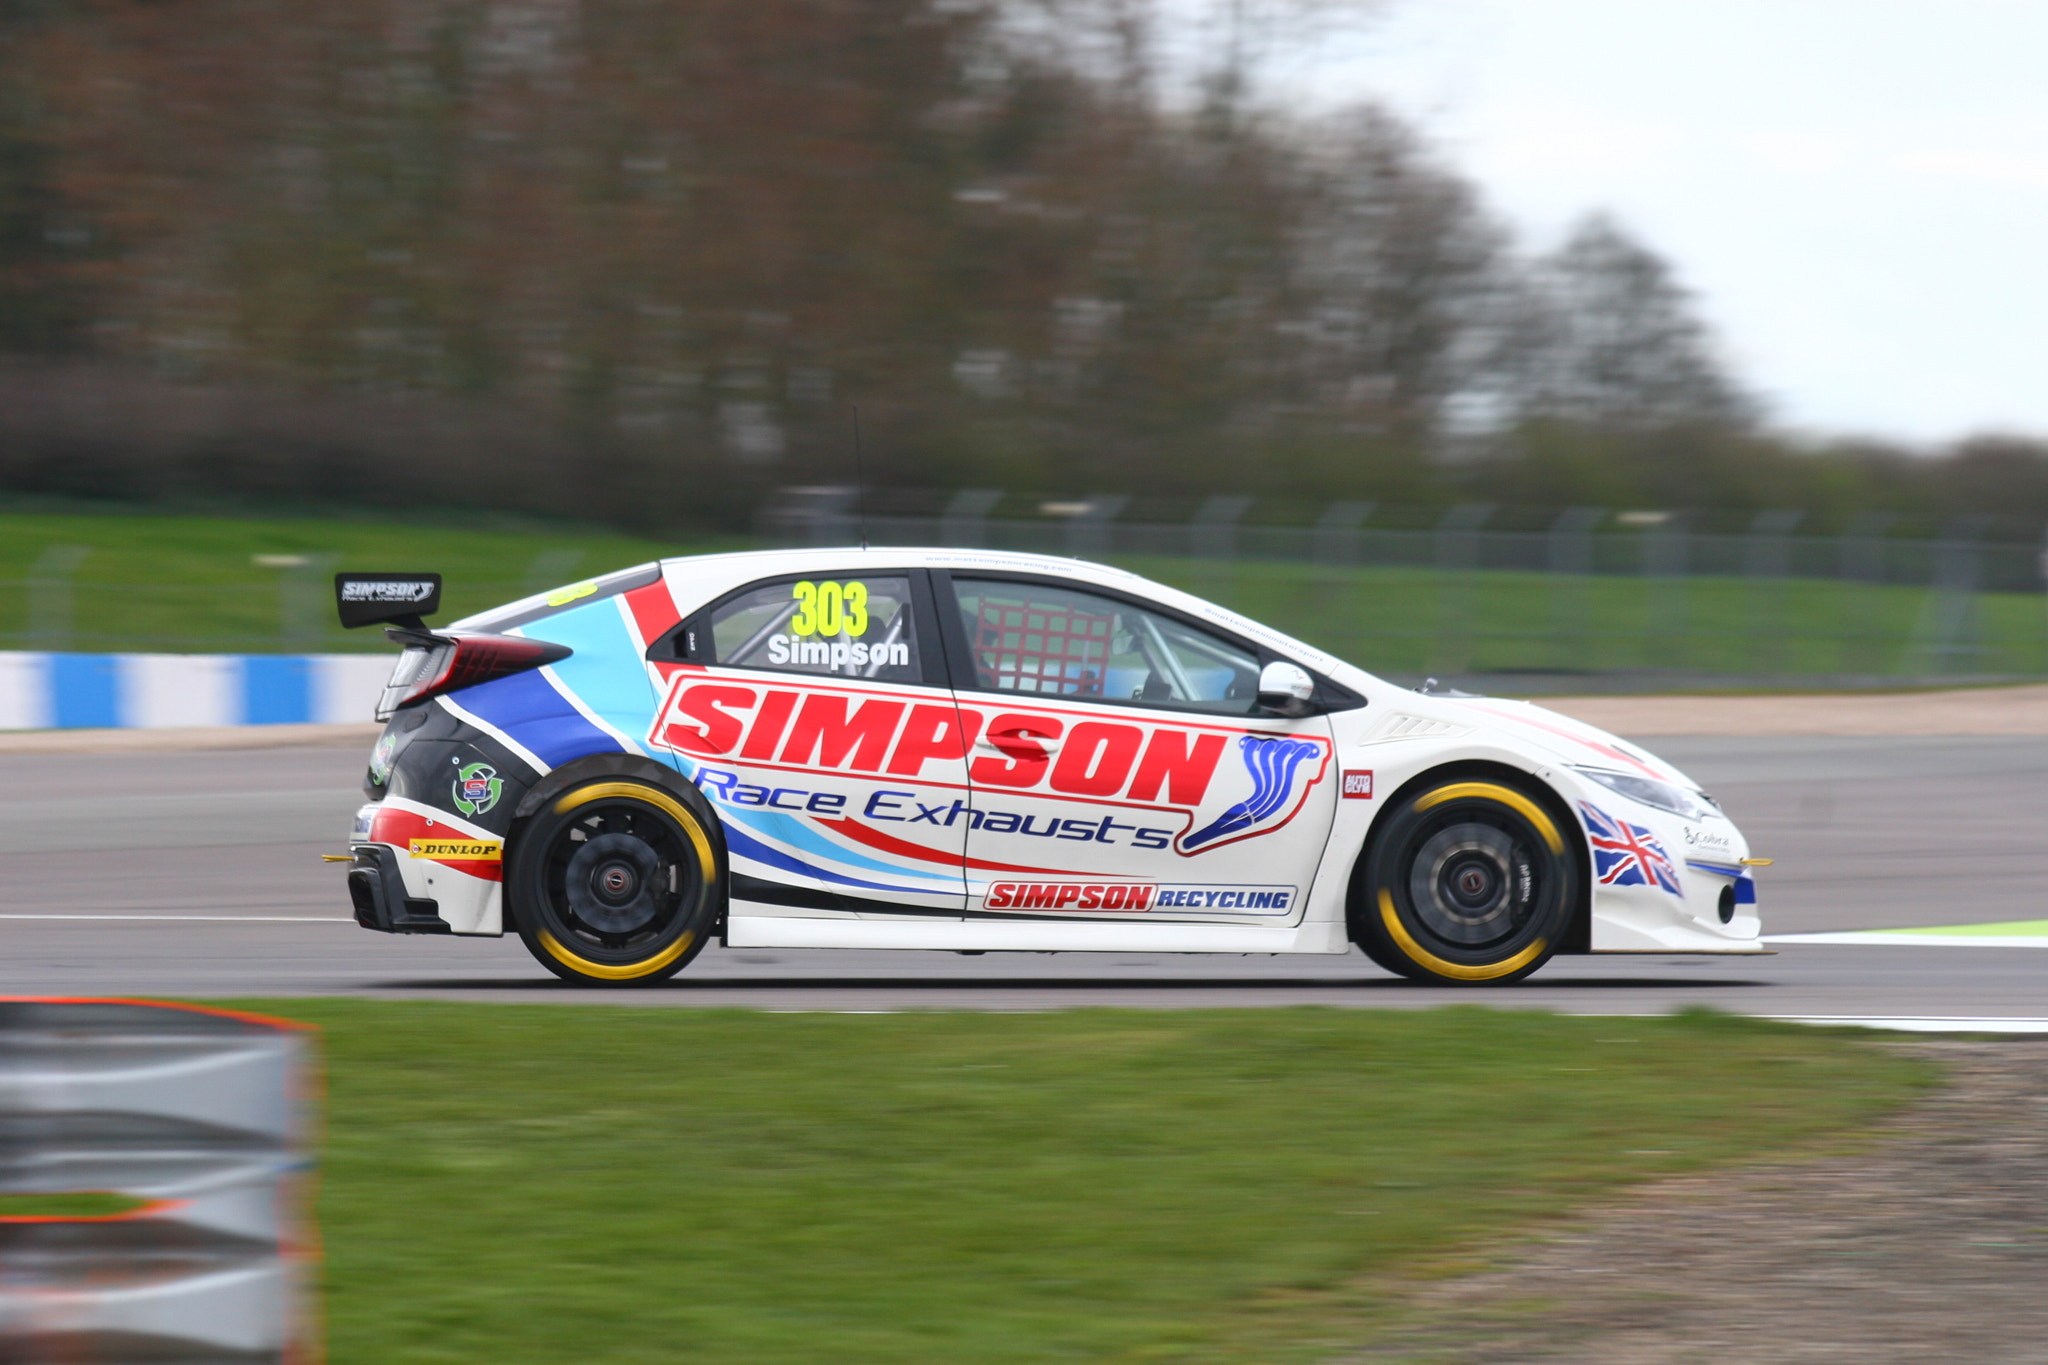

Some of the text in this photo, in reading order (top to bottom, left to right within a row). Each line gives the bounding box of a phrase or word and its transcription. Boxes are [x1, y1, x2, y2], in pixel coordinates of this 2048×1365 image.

[342, 581, 422, 596] SIMPSON
[791, 580, 868, 637] 303
[768, 633, 909, 671] Simpson
[662, 684, 1229, 806] SIMPSON
[693, 766, 1174, 850] Race Exhausts
[423, 844, 497, 855] DUNLOP
[988, 884, 1290, 910] SIMPSON RECYCLING
